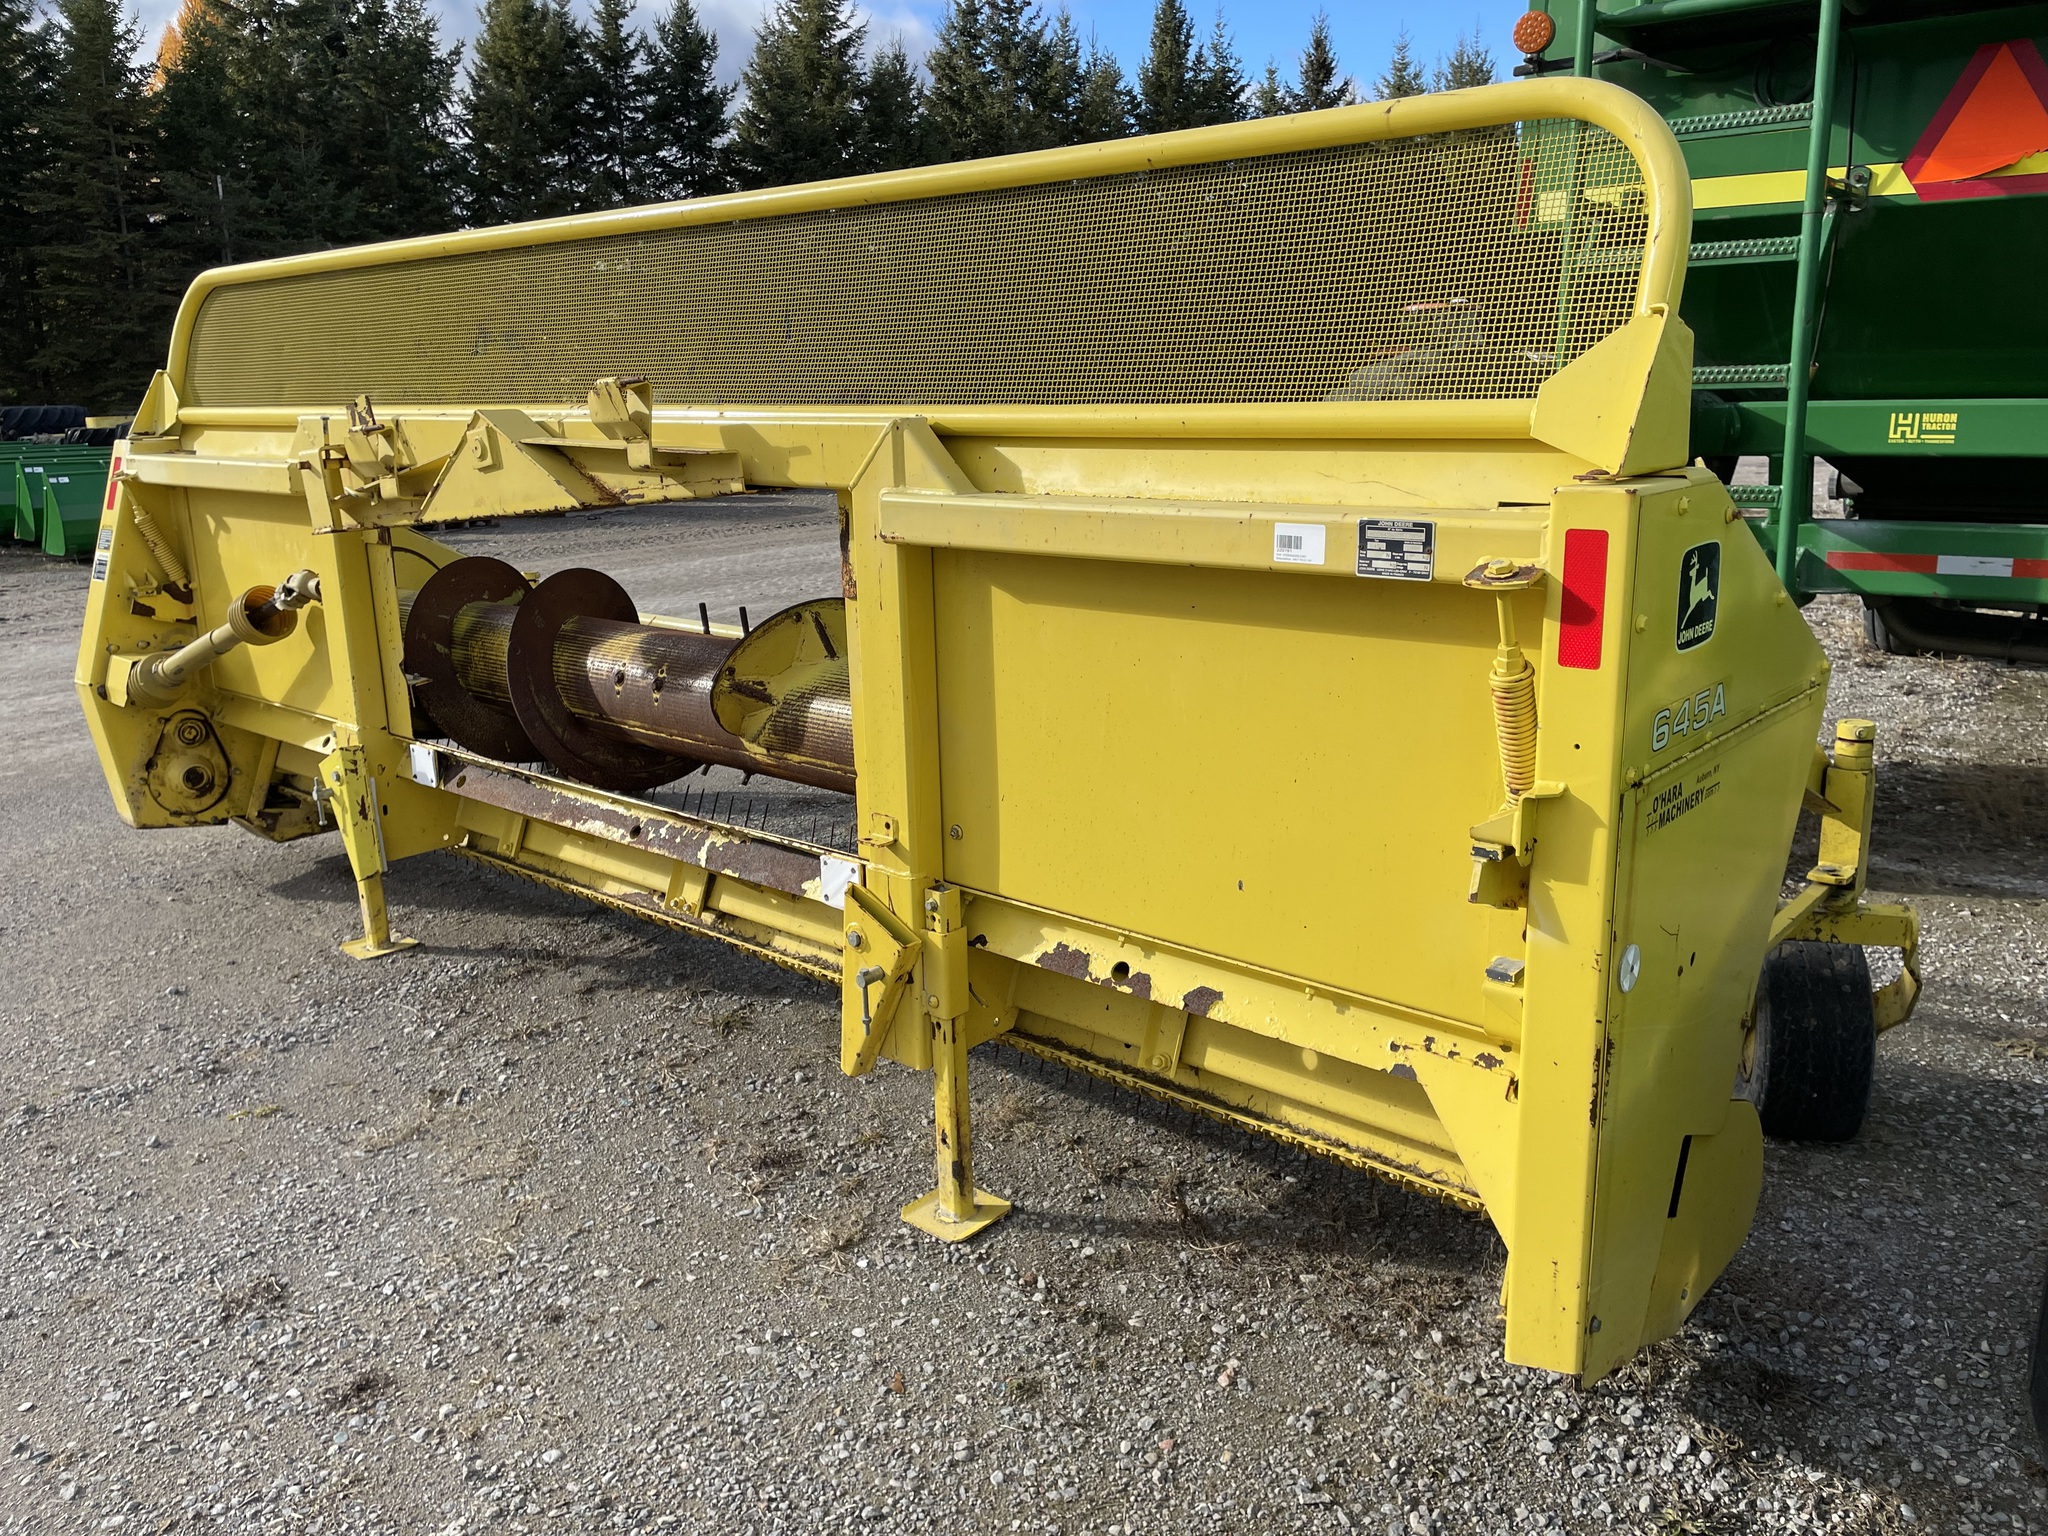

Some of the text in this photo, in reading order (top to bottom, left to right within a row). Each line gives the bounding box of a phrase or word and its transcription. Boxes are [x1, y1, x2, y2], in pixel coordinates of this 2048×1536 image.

[1922, 413, 1958, 423] HURON
[1678, 620, 1713, 644] JOHN DEERE
[1652, 682, 1726, 752] 645A
[1713, 764, 1720, 774] NY
[1653, 782, 1683, 814] O'HARA
[1658, 786, 1706, 830] MACHINERY
